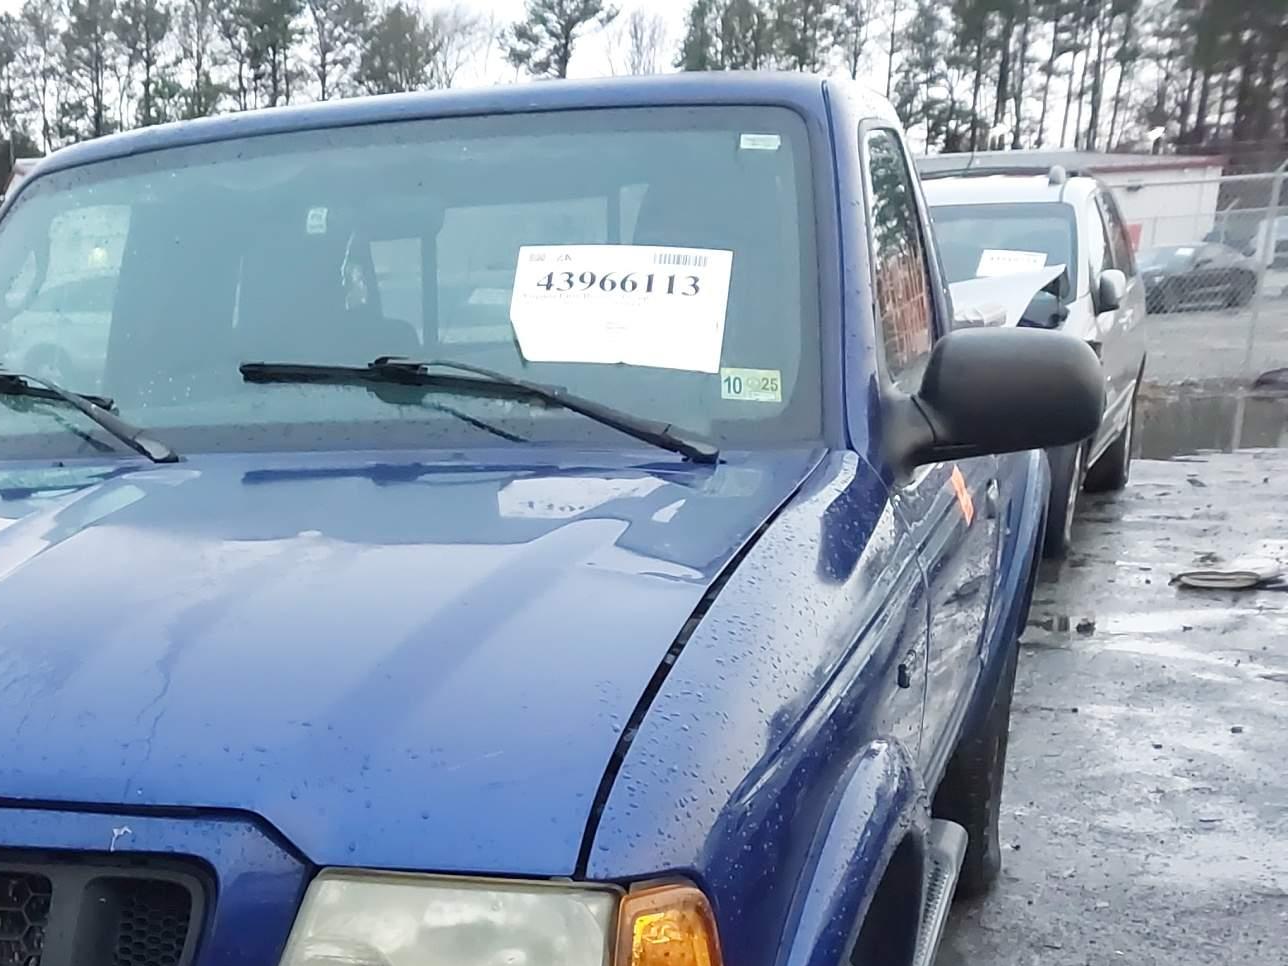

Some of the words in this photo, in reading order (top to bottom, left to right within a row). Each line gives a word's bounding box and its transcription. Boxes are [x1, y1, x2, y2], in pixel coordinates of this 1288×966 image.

[536, 271, 701, 297] 43966113
[723, 375, 743, 395] 10
[760, 377, 779, 392] 25
